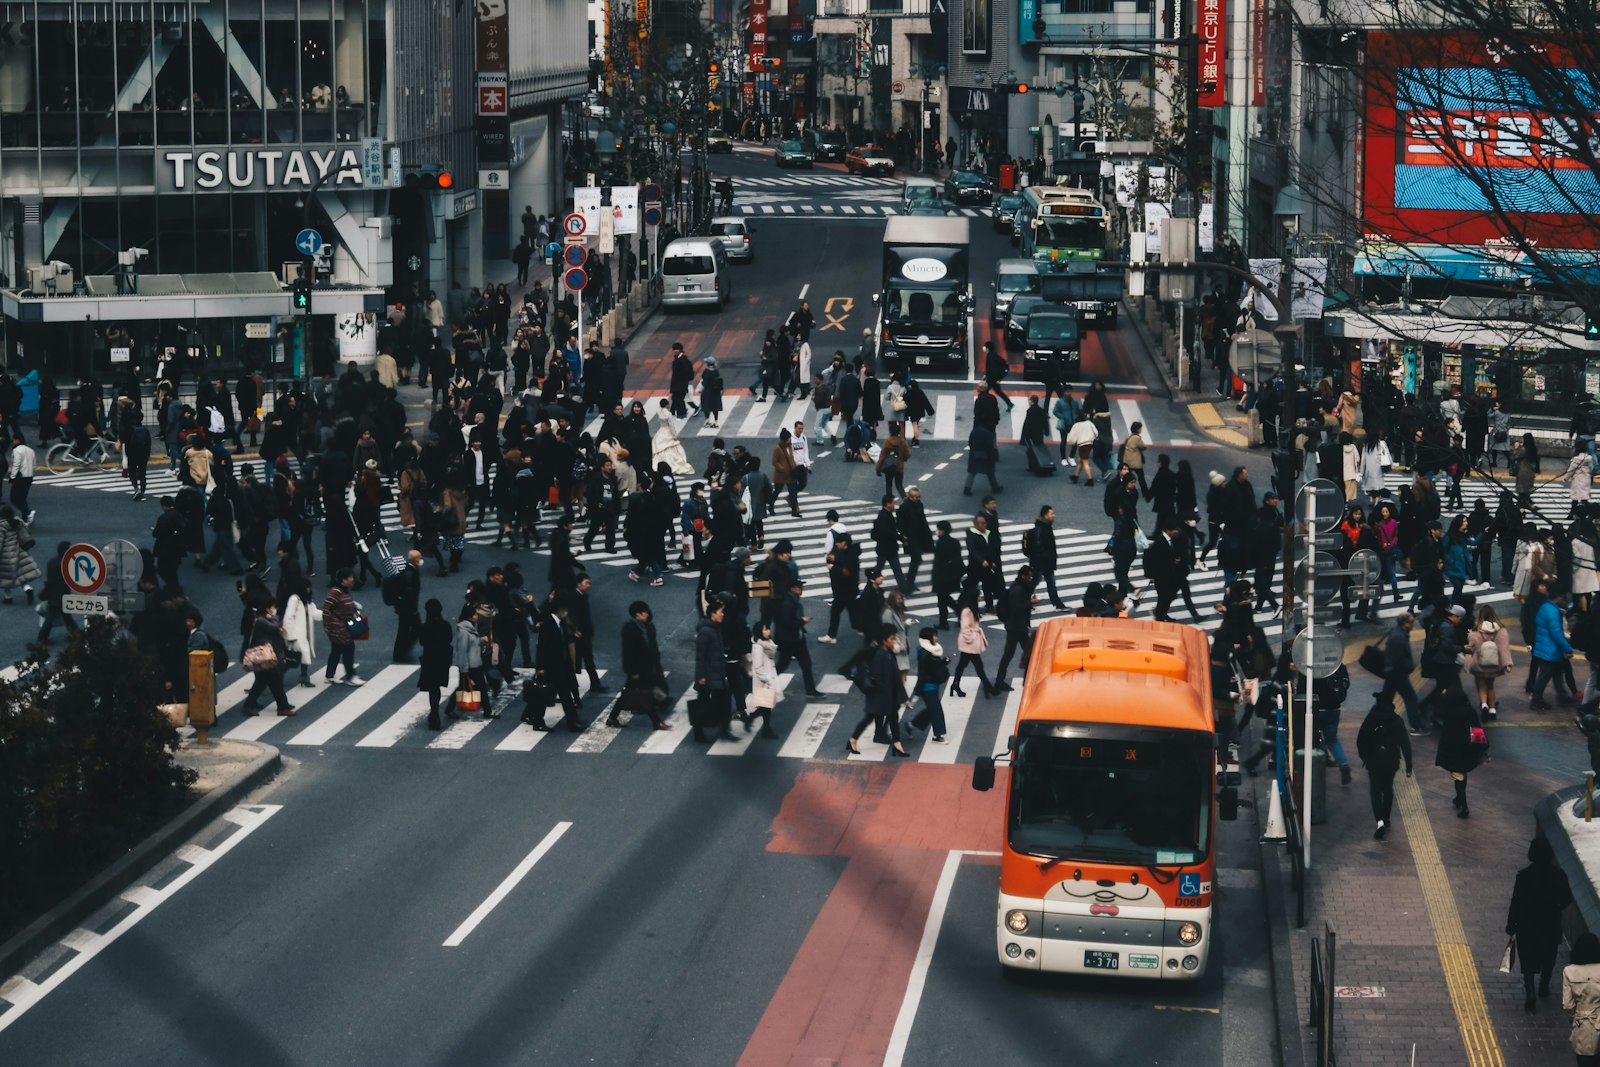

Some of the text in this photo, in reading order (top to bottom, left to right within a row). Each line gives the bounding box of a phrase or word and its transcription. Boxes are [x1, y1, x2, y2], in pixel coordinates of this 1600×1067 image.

[483, 89, 503, 109] 本
[967, 89, 990, 111] ZARA
[166, 150, 363, 188] TSUTAYA
[370, 141, 381, 185] 渋谷駅前
[906, 264, 944, 273] Minette
[66, 600, 105, 612] ここから
